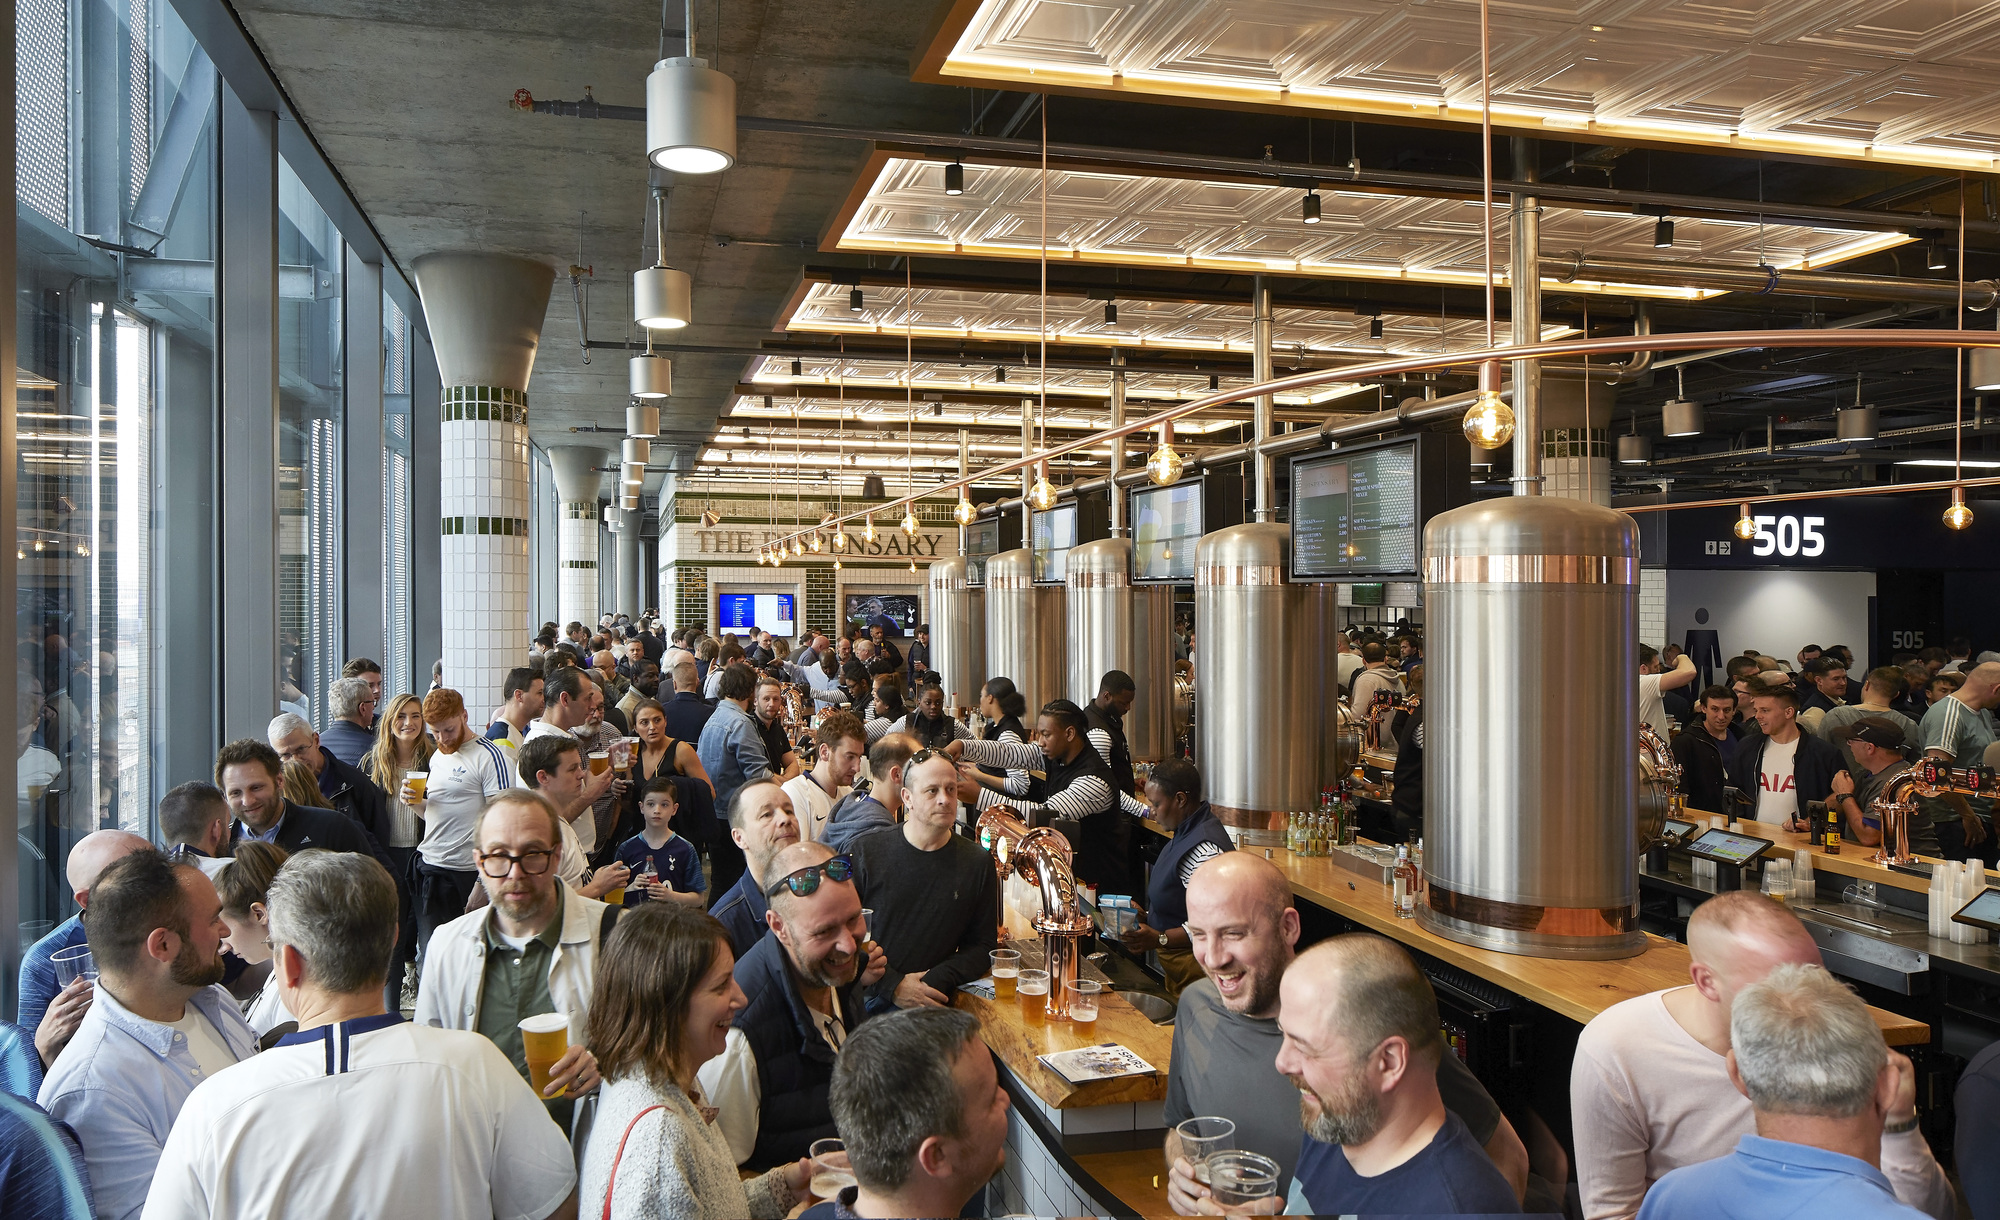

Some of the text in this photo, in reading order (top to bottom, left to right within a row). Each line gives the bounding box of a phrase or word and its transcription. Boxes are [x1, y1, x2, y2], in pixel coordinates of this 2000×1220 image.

[694, 530, 753, 553] THE
[1753, 515, 1825, 557] 505
[1892, 630, 1924, 649] 505
[1760, 772, 1795, 793] AIA
[1118, 1051, 1147, 1069] SPURS
